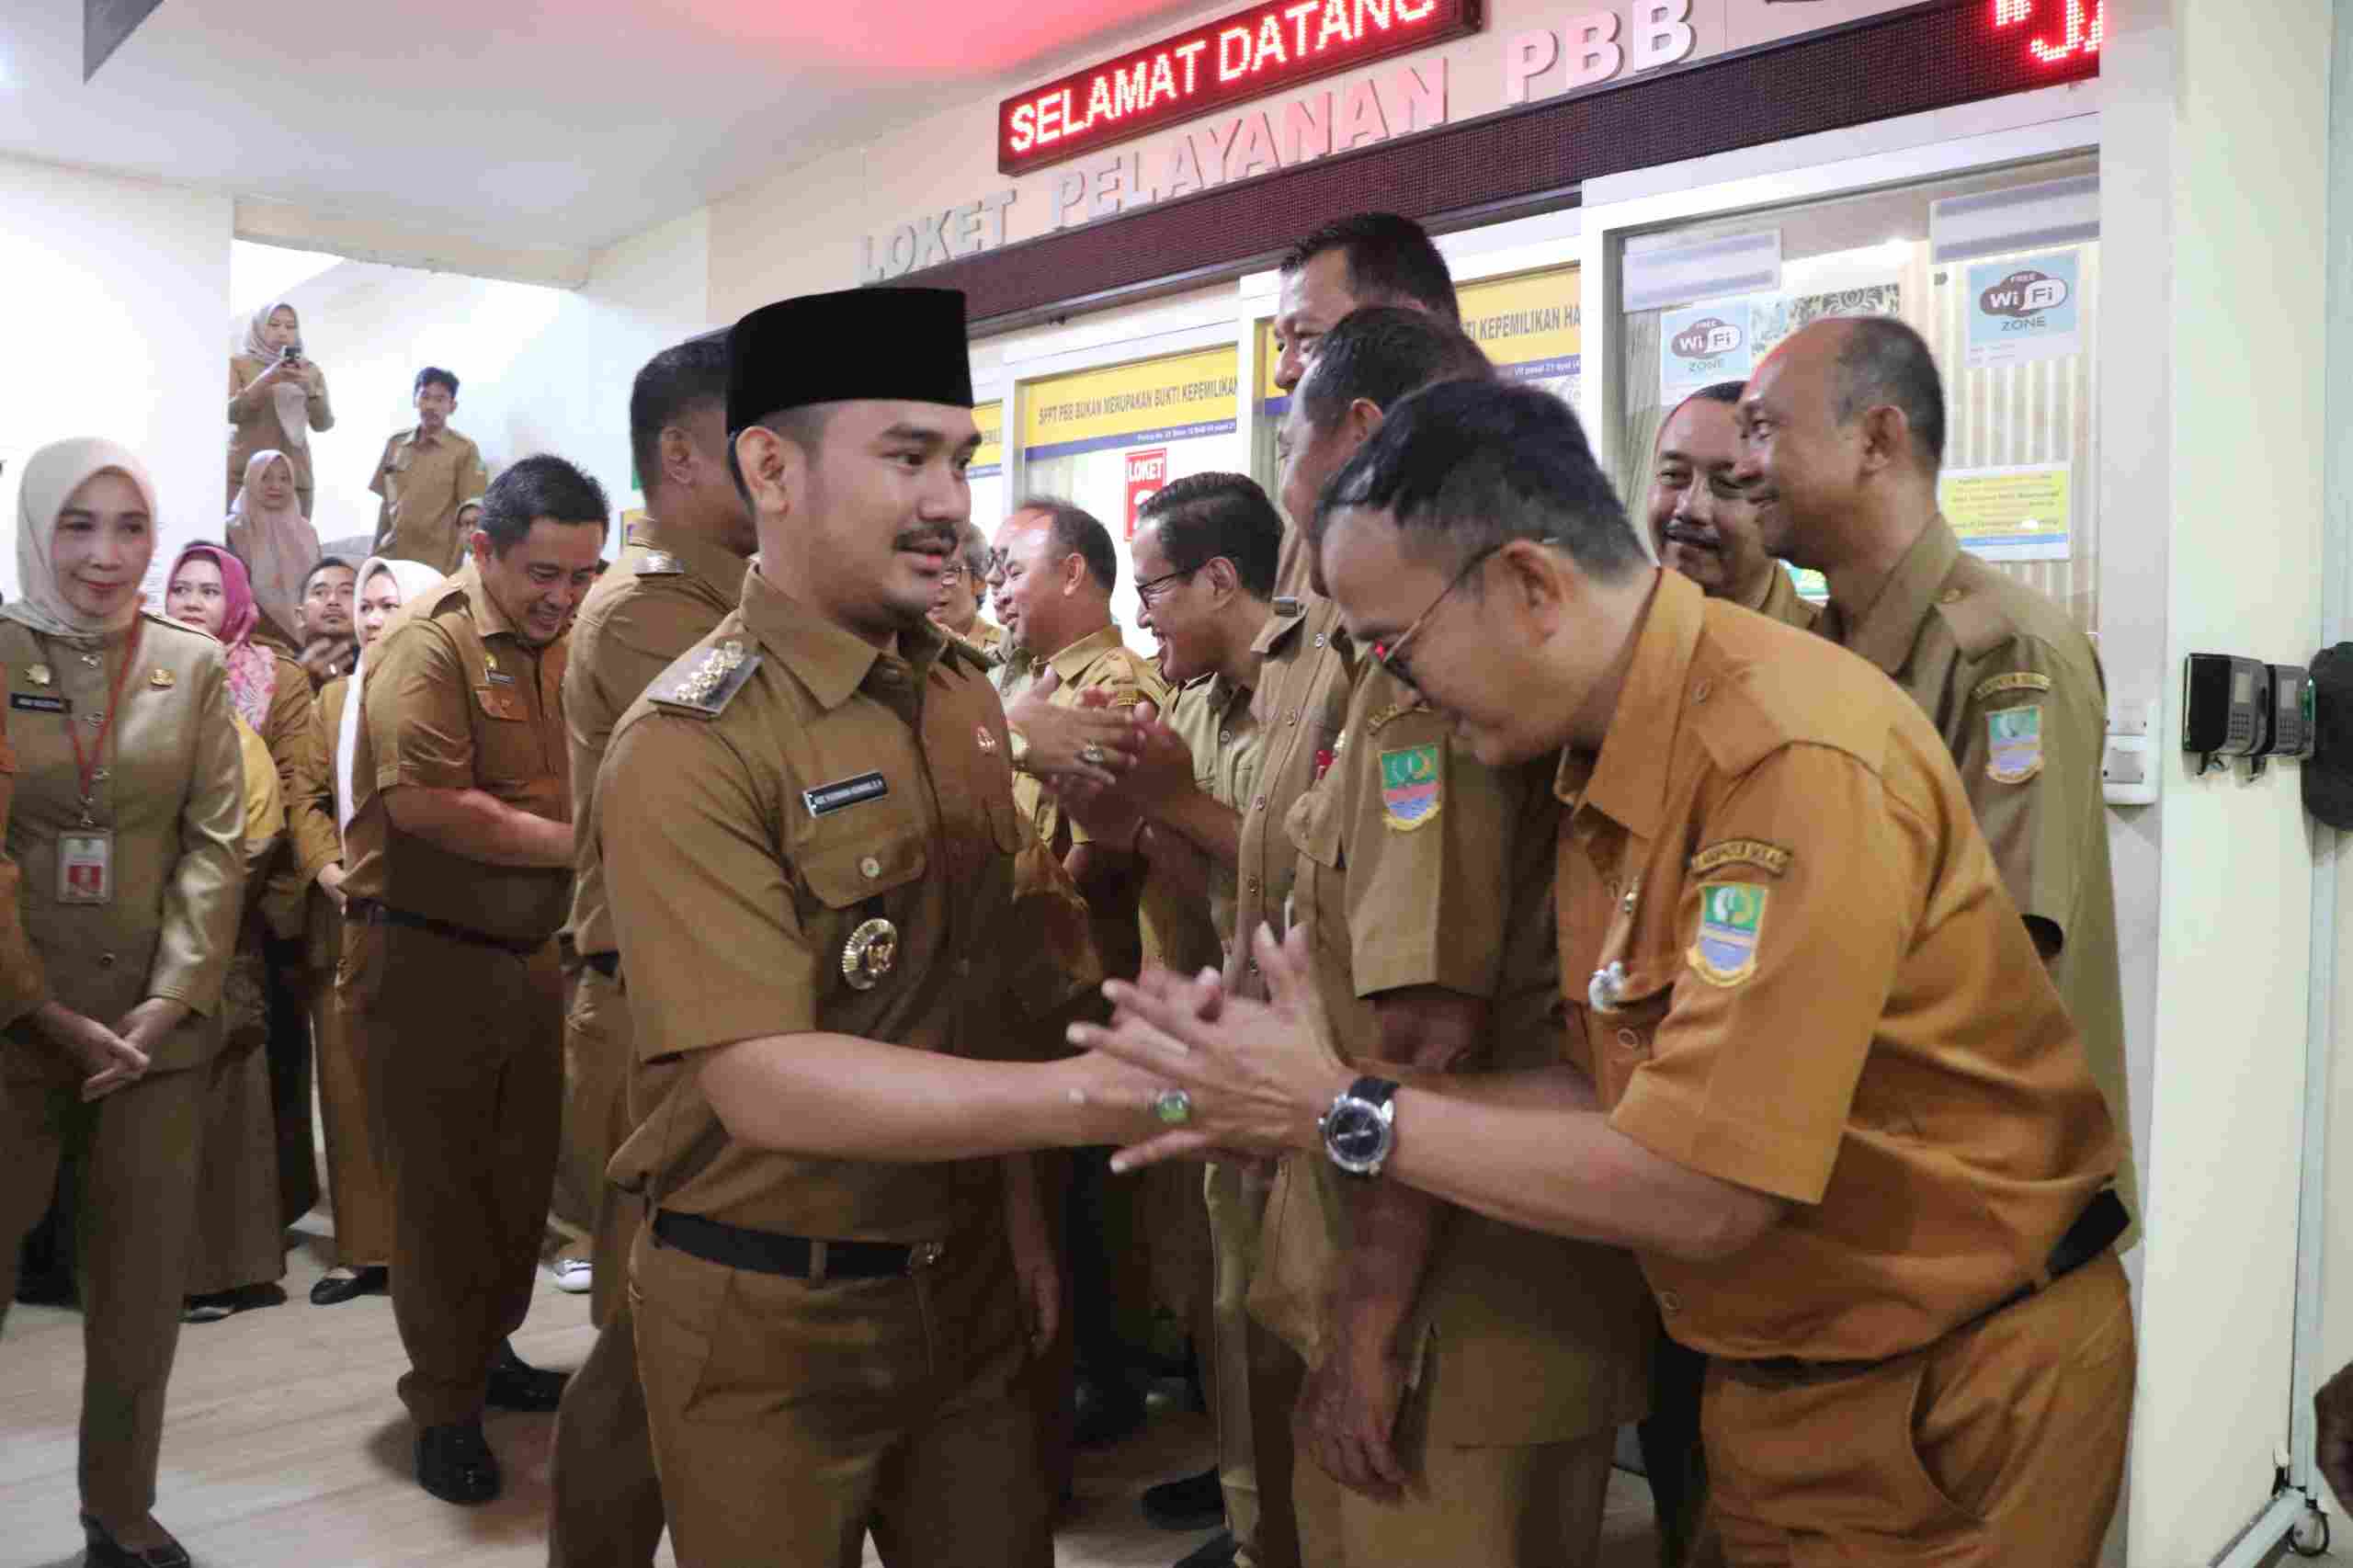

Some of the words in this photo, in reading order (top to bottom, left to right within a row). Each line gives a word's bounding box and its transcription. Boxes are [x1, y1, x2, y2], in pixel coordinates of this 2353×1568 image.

[1010, 40, 1206, 153] SELAMAT
[860, 187, 1017, 283] LOKET
[1051, 56, 1448, 228] PELAYANAN
[1505, 0, 1698, 103] PBB
[1480, 307, 1560, 339] KEPEMILIKAN
[2001, 316, 2045, 332] ZONE
[1104, 389, 1153, 415] MERUPAKAN
[1128, 457, 1164, 483] LOKET
